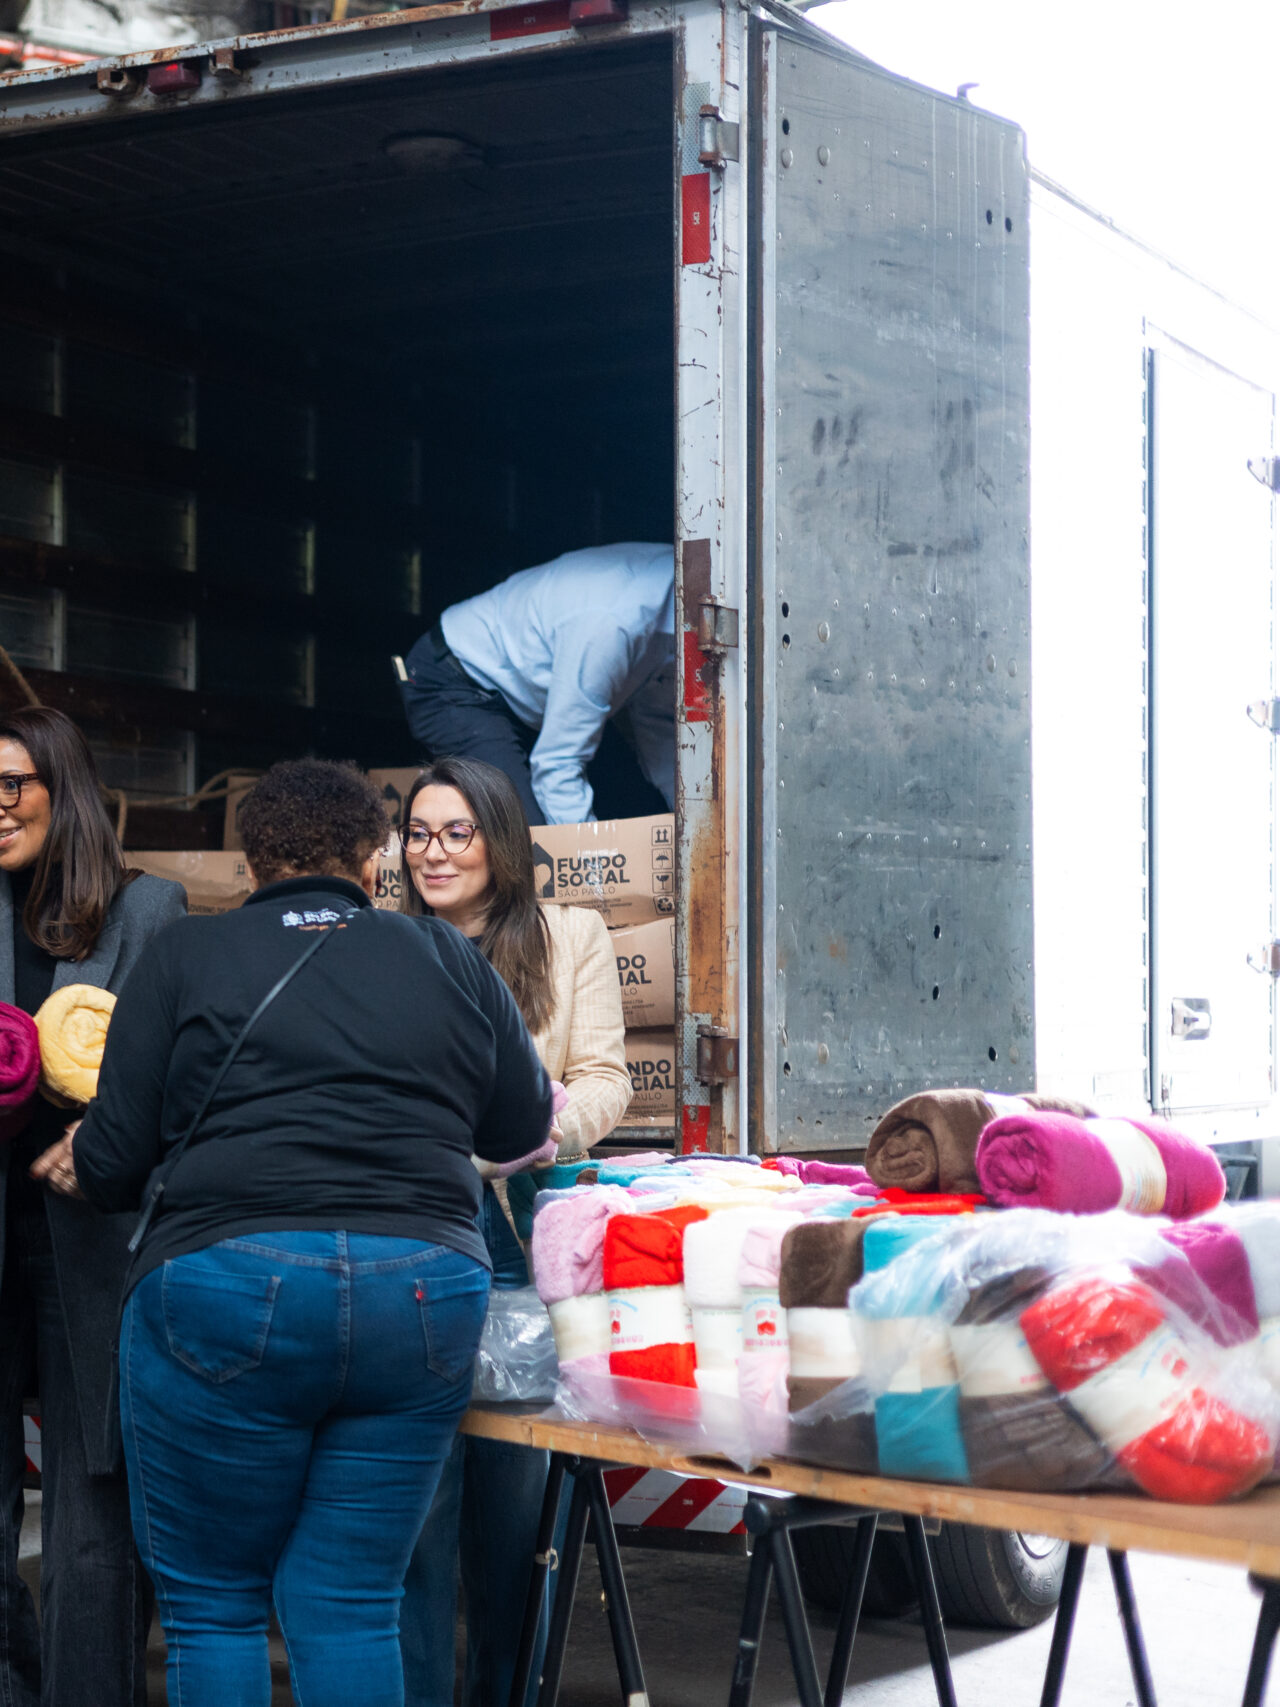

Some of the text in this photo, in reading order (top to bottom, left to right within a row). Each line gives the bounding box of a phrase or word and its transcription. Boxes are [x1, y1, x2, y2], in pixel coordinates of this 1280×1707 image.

[557, 853, 626, 872] FUNDO
[557, 869, 630, 888] SOCIAL
[558, 886, 616, 898] SÃO PALO
[618, 969, 652, 987] IAL
[626, 1059, 671, 1075] NDO
[631, 1075, 675, 1091] CIAL
[634, 1092, 662, 1101] AULO
